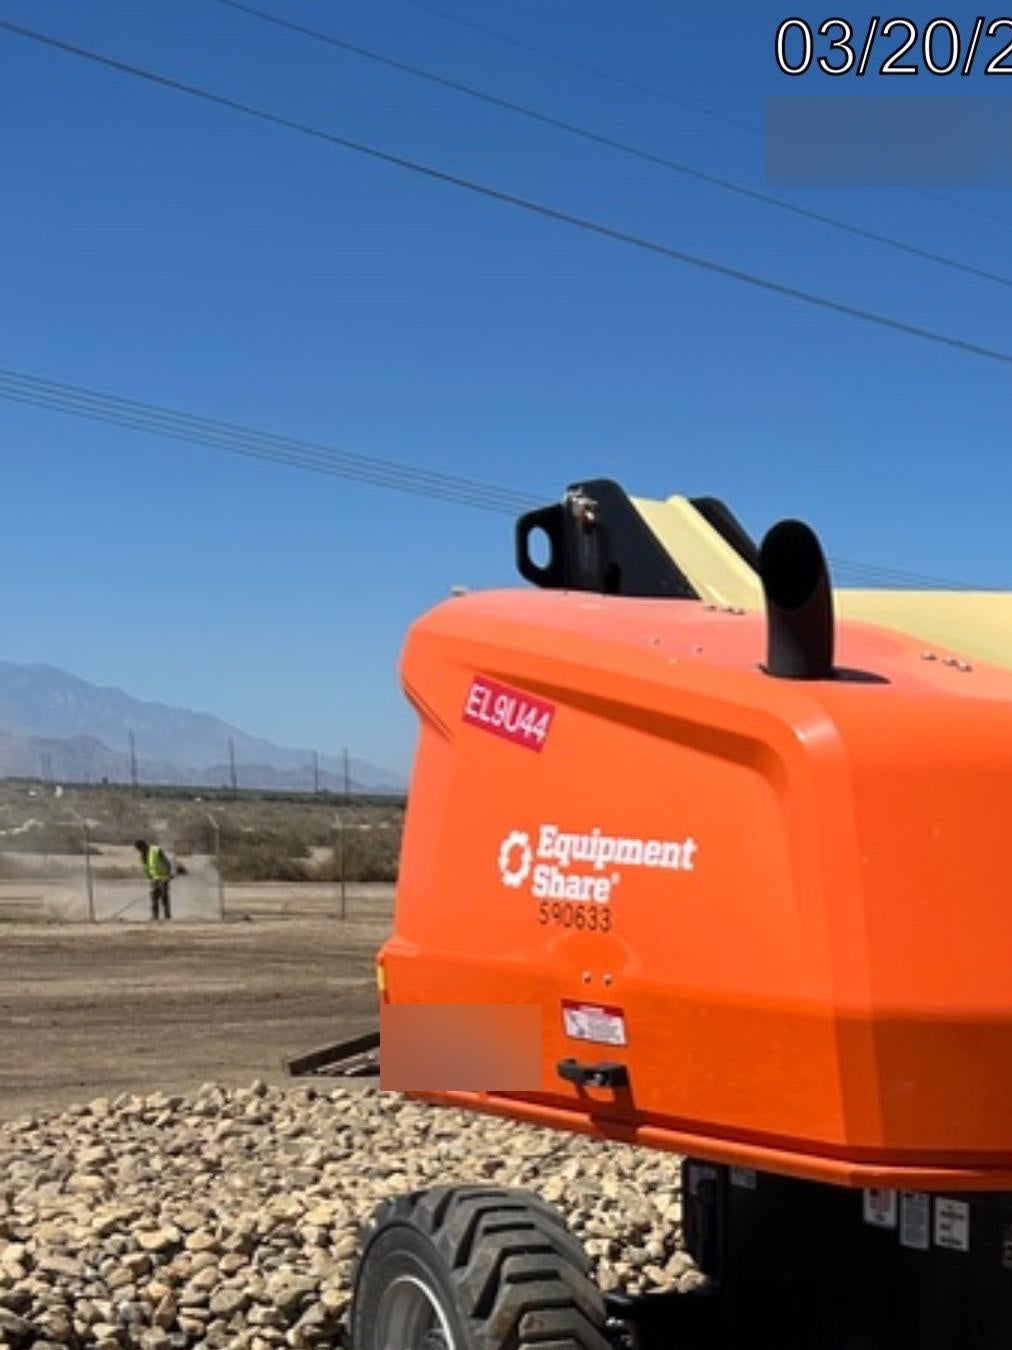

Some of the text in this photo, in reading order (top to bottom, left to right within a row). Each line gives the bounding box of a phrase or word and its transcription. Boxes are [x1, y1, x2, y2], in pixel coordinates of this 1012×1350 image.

[465, 683, 550, 742] EL9U44
[537, 824, 698, 870] Equipment
[532, 864, 612, 903] Share
[538, 902, 612, 932] 590633
